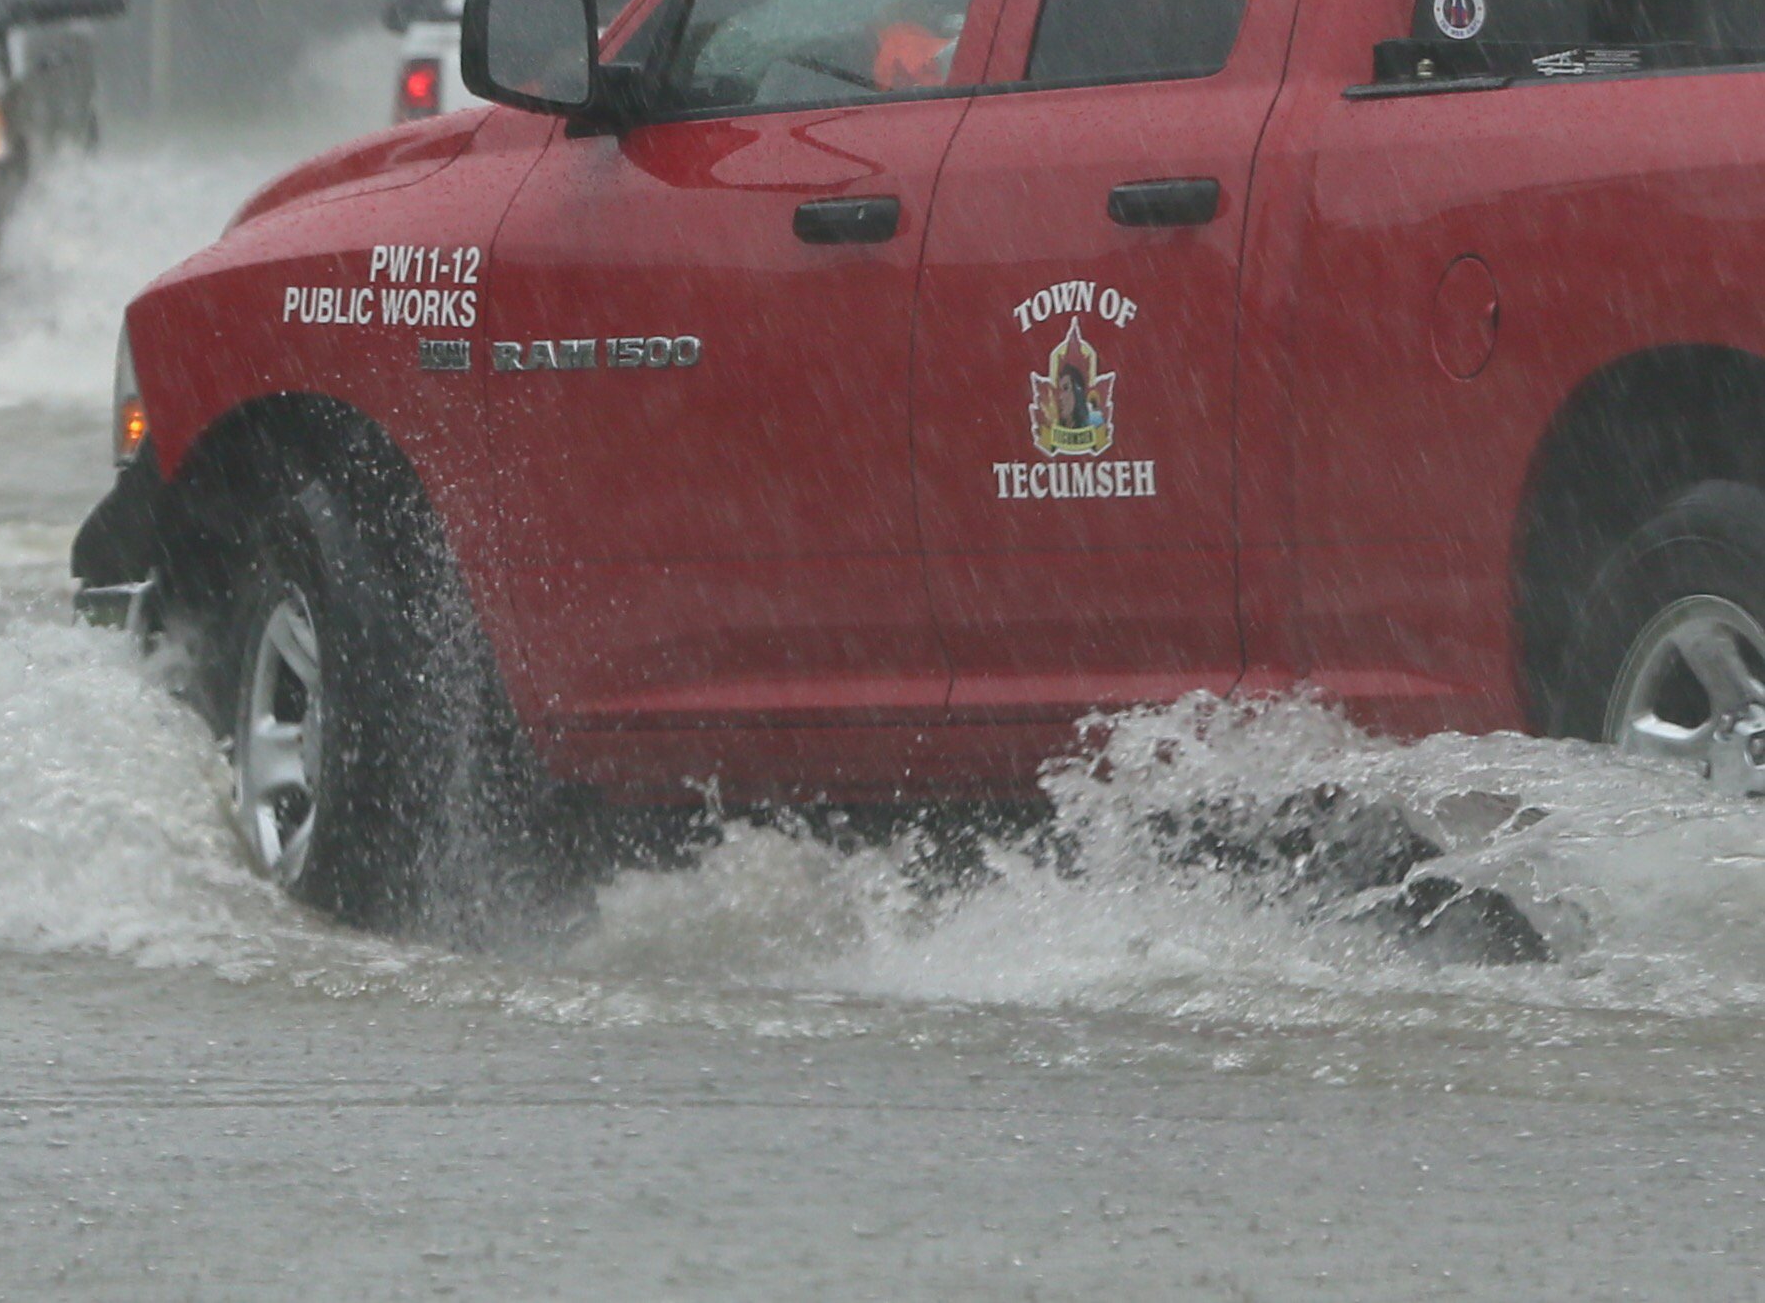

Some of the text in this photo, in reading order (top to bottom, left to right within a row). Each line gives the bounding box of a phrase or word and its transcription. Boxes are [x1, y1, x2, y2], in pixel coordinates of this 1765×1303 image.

[369, 245, 480, 284] PW11-12
[283, 286, 477, 327] PUBLIC WORKS
[1013, 280, 1138, 333] TOWN OF
[492, 338, 598, 371] RAM
[606, 336, 701, 368] 1500
[993, 460, 1157, 499] TECUMSEH
